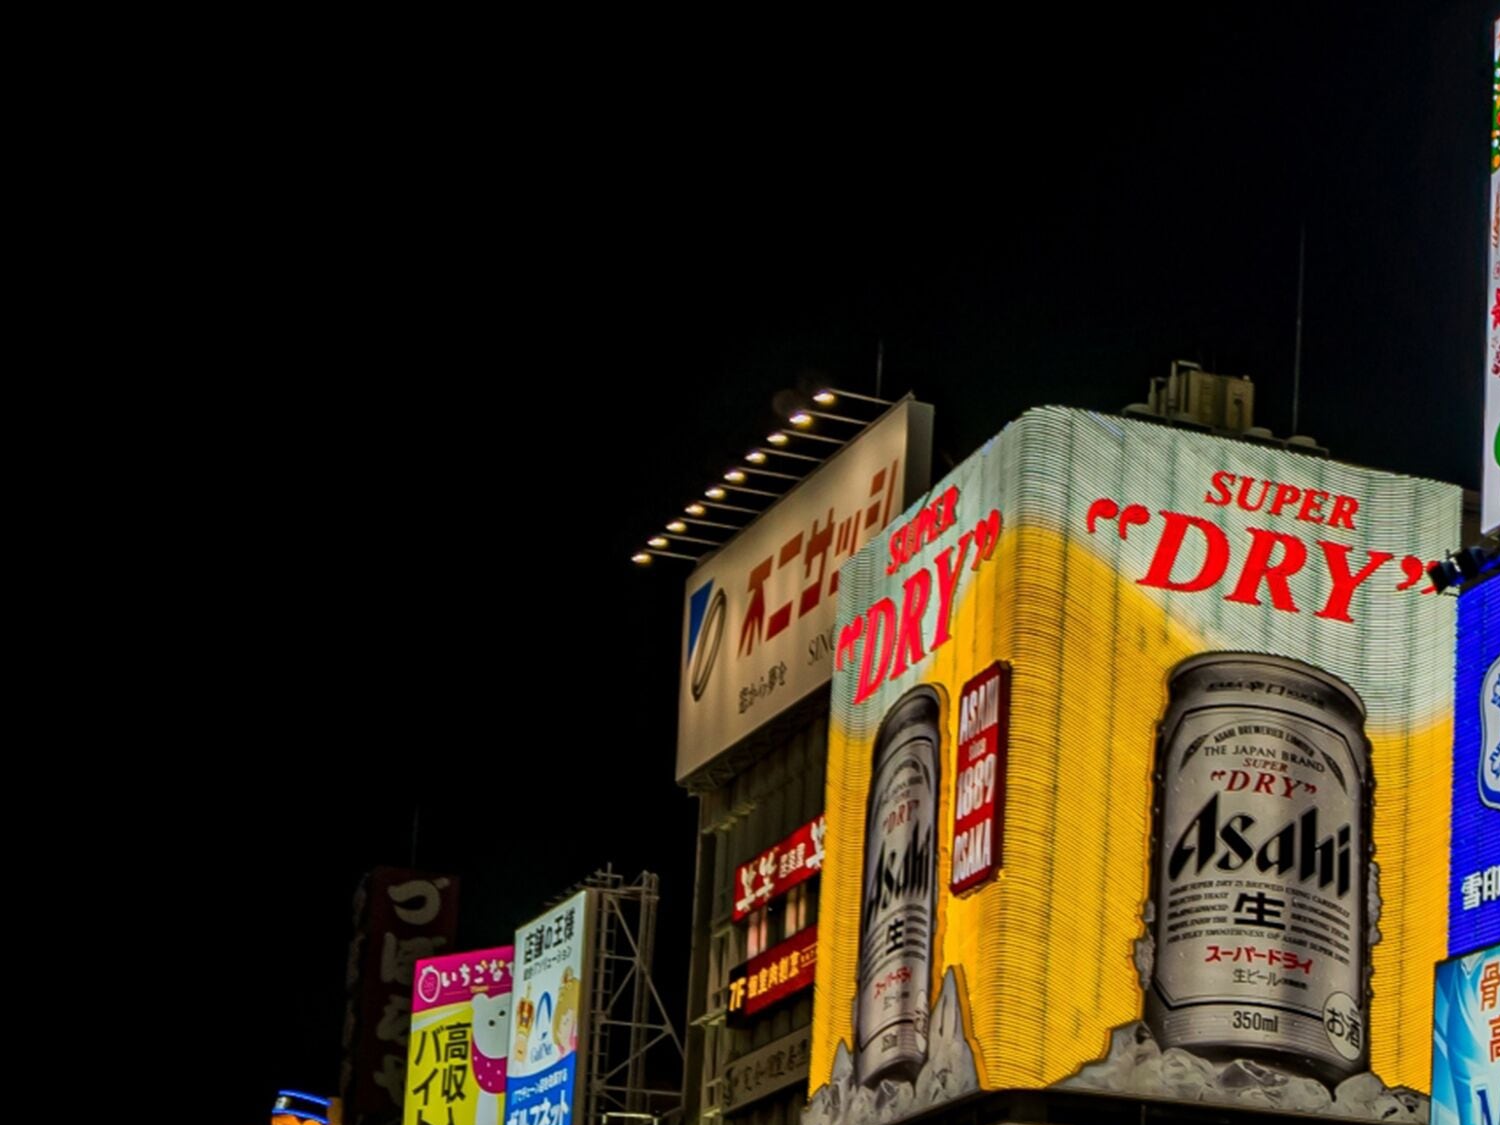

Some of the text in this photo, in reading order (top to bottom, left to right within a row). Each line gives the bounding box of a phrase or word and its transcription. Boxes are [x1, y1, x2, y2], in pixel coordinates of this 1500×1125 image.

[1203, 469, 1359, 531] SUPER
[886, 485, 960, 576] SUPER
[960, 675, 998, 745] ASAHI
[1204, 745, 1325, 773] THE JAPAN BRAND
[1242, 757, 1288, 773] SUPER
[956, 753, 995, 820] 1889
[954, 818, 992, 886] OSAKA
[1168, 791, 1351, 898] Asahi
[1233, 892, 1286, 930] 生
[1205, 946, 1313, 974] スーパードライ
[729, 976, 746, 1012] 7F
[1232, 1010, 1279, 1033] 350ml
